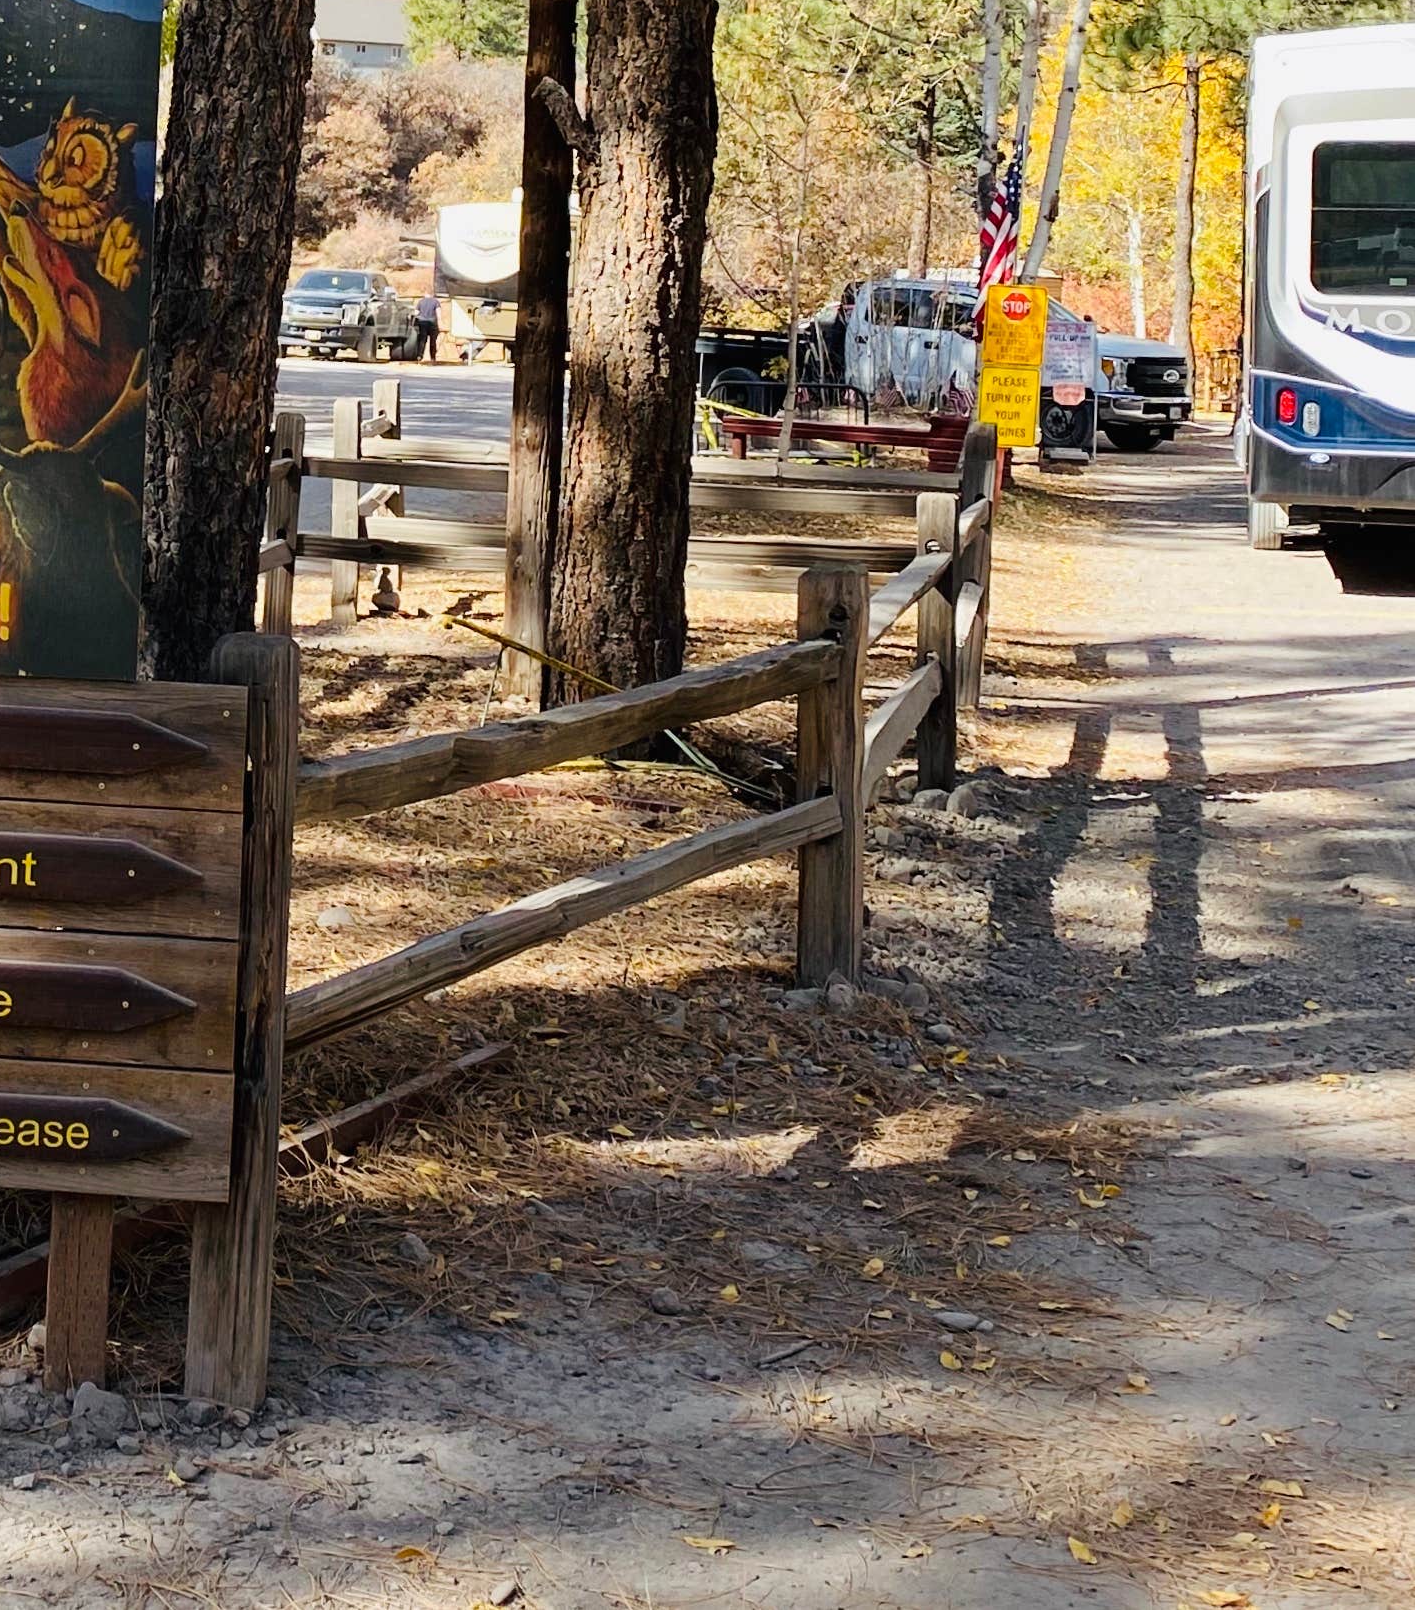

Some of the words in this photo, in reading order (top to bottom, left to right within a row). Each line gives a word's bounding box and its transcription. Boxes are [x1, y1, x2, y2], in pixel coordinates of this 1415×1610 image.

[1002, 300, 1032, 313] STOP
[993, 376, 1027, 386] PLEASE
[986, 392, 1011, 403] TURN
[1015, 393, 1032, 404] OFF
[995, 410, 1020, 420] YOUR
